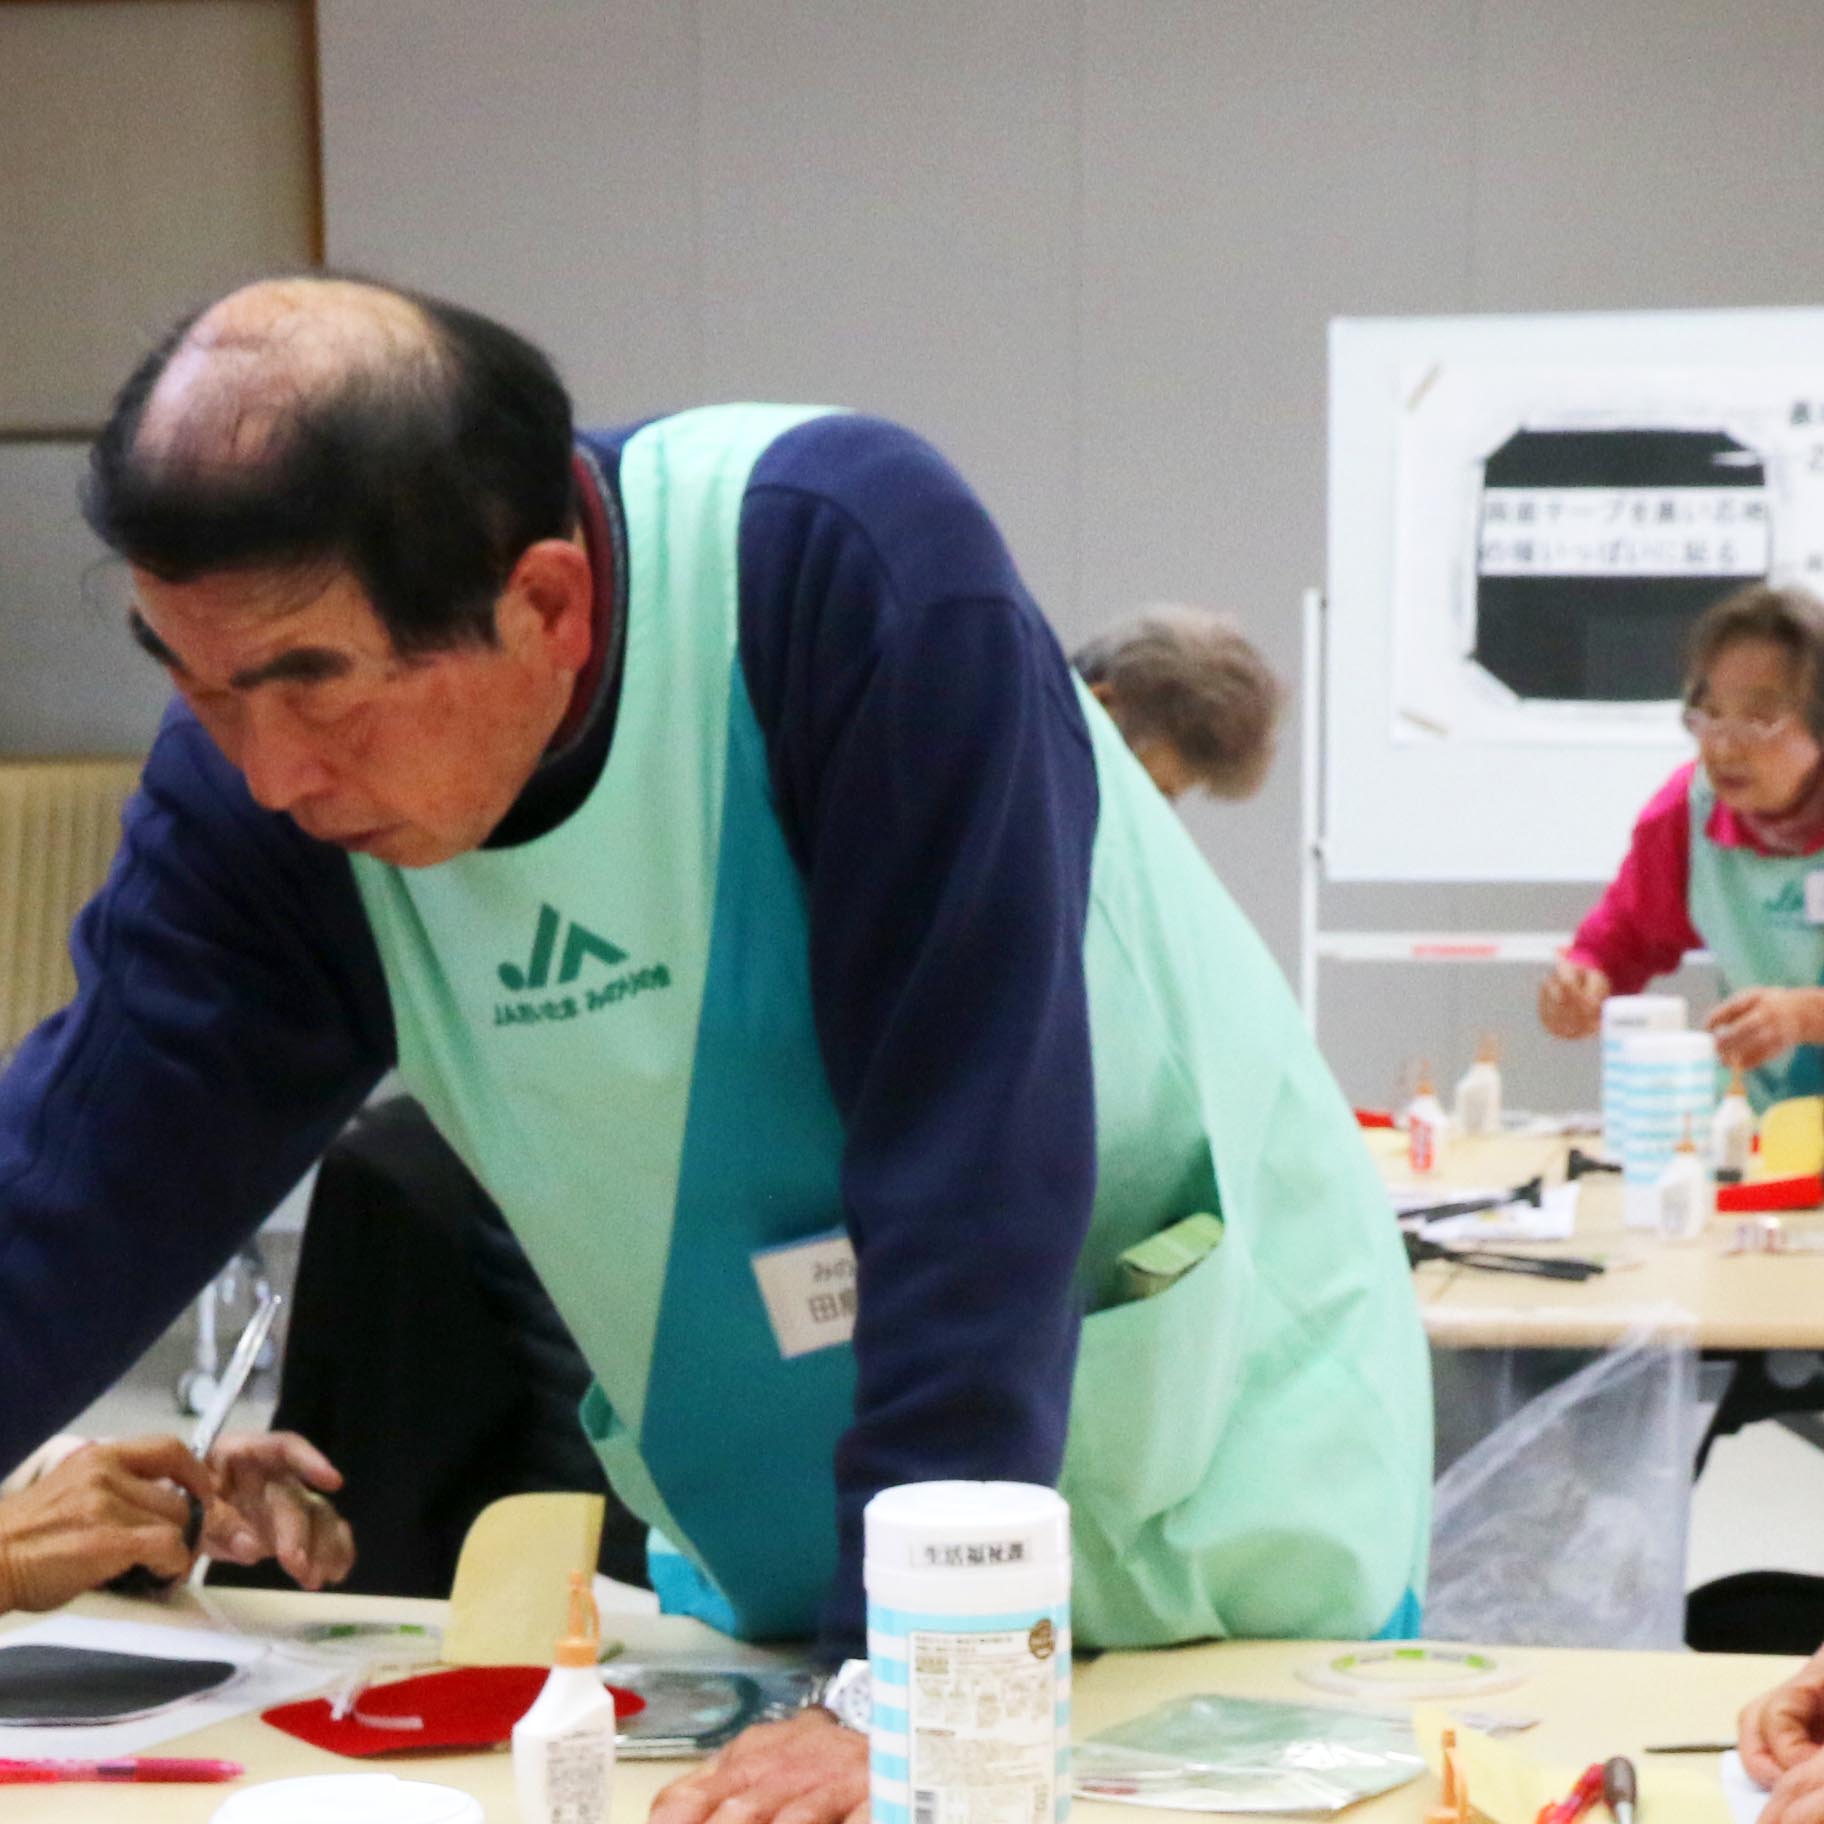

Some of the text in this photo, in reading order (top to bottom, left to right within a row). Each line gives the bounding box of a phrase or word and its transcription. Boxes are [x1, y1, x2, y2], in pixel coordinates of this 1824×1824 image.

[923, 1540, 1026, 1568] 生活福祉課
